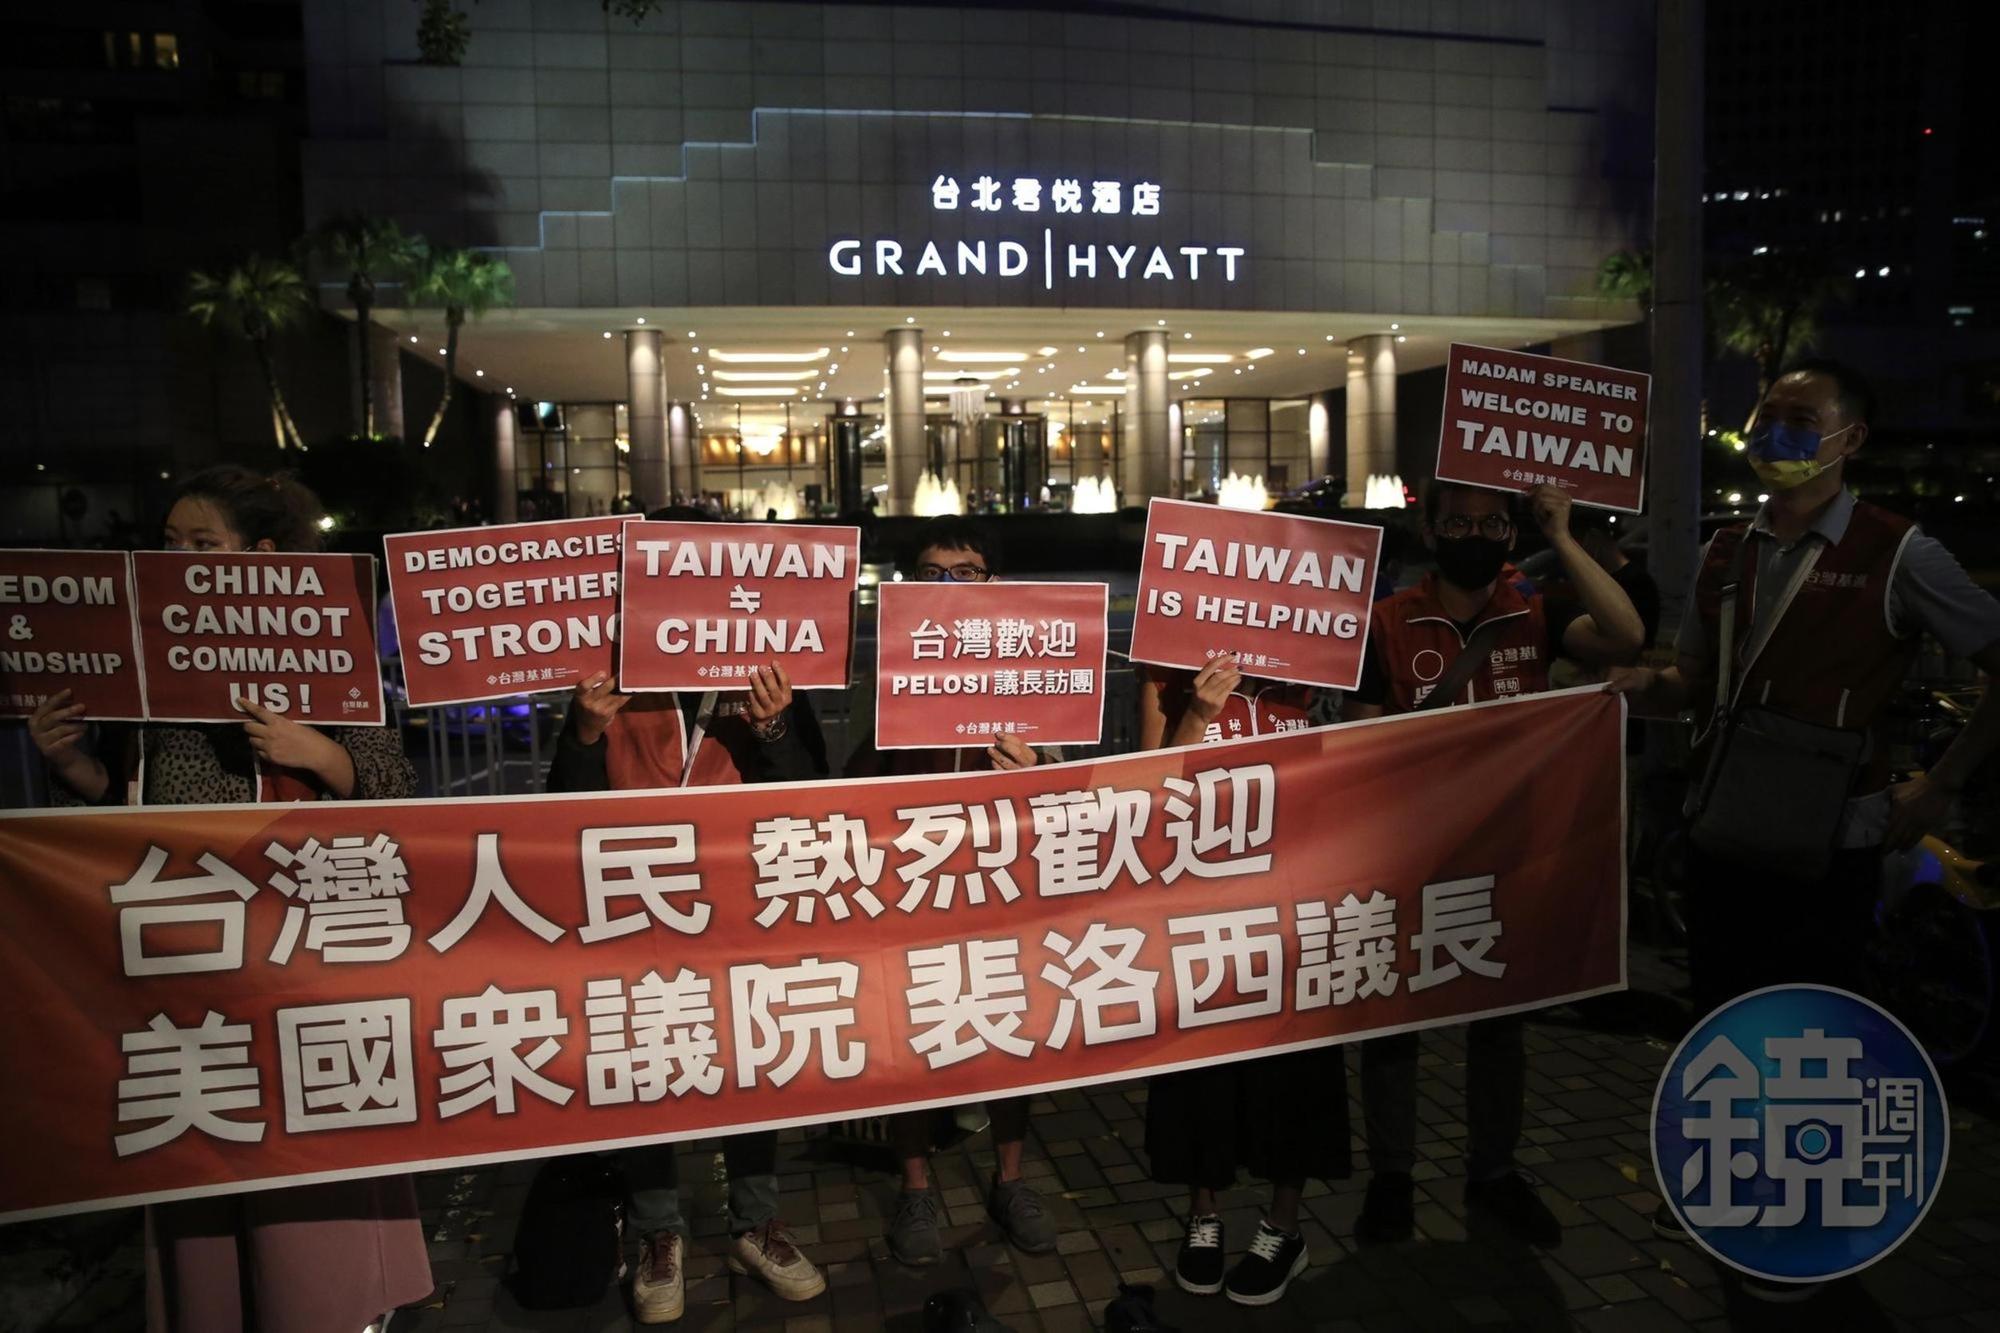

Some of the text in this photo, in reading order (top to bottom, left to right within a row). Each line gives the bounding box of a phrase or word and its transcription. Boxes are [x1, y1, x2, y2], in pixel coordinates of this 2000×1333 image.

[829, 240, 1245, 281] GRAND HYATT
[1462, 360, 1638, 401] MADAM SPEAKER
[1461, 388, 1634, 433] WELCOME TO
[1456, 420, 1634, 477] TAIWAN
[636, 540, 846, 578] TAIWAN
[1155, 533, 1365, 593] TAIWAN
[184, 564, 325, 596] CHINA
[162, 604, 350, 637] CANNOT
[1146, 589, 1359, 639] IS HELPING
[656, 618, 824, 653] CHINA
[910, 618, 1077, 660] 台灣歡迎
[167, 646, 354, 673] COMMAND
[498, 668, 553, 685] 台灣基進
[110, 764, 1276, 976] 台灣人民 熱烈歡迎
